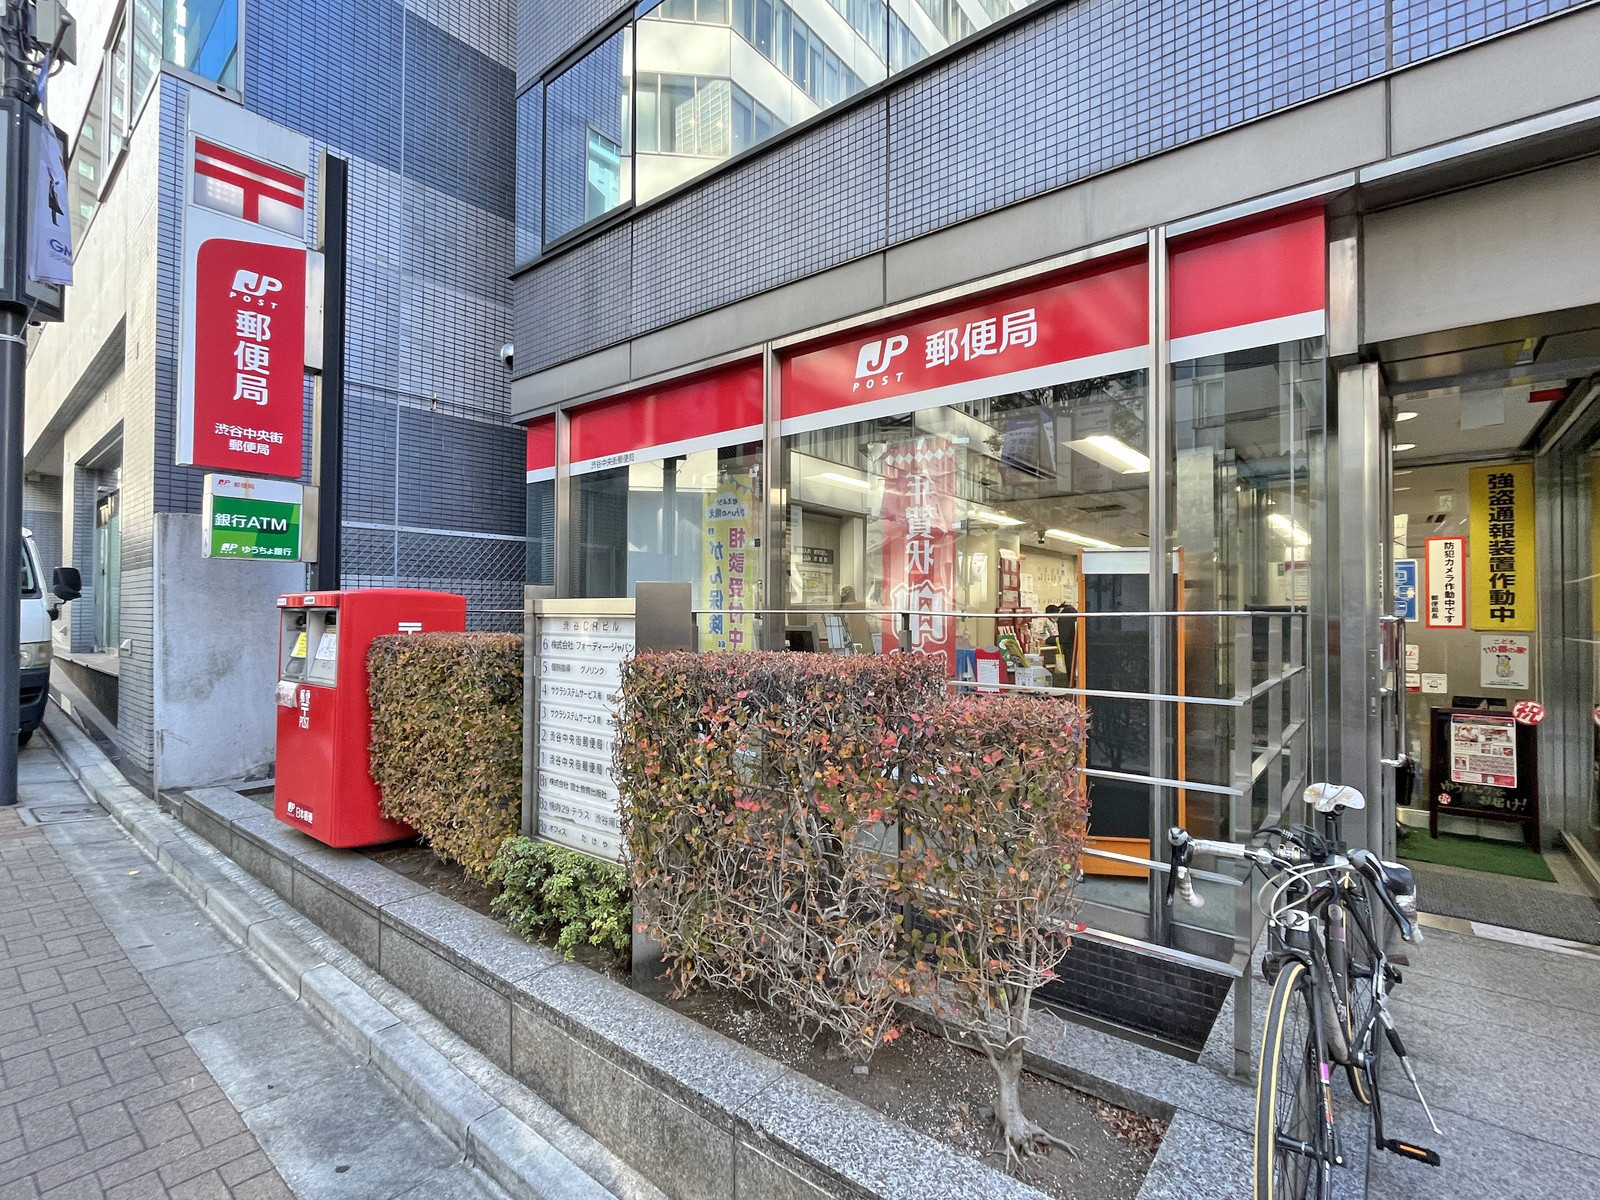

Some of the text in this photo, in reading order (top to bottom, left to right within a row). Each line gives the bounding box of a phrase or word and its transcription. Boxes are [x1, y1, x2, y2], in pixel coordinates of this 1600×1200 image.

[229, 292, 278, 309] POST
[925, 307, 1038, 369] 郵便局
[233, 309, 271, 406] 郵便局
[852, 371, 904, 393] POST
[214, 422, 284, 444] 渋谷中央街
[228, 438, 270, 456] 郵便局
[590, 452, 635, 470] 渋谷中央街郵便局
[214, 513, 287, 531] 銀行ATM
[241, 545, 292, 556] ゆうちょ銀行
[1487, 472, 1516, 623] 強盗通報装置作動中
[1443, 541, 1456, 624] 防犯カメラ作動中です
[543, 637, 549, 651] 6
[551, 640, 574, 651] 株式会社
[1483, 645, 1528, 655] 110番の家
[1494, 638, 1517, 646] こども
[542, 661, 548, 674] 5
[541, 683, 548, 697] 4
[541, 705, 547, 719] 3
[541, 729, 547, 742] 2
